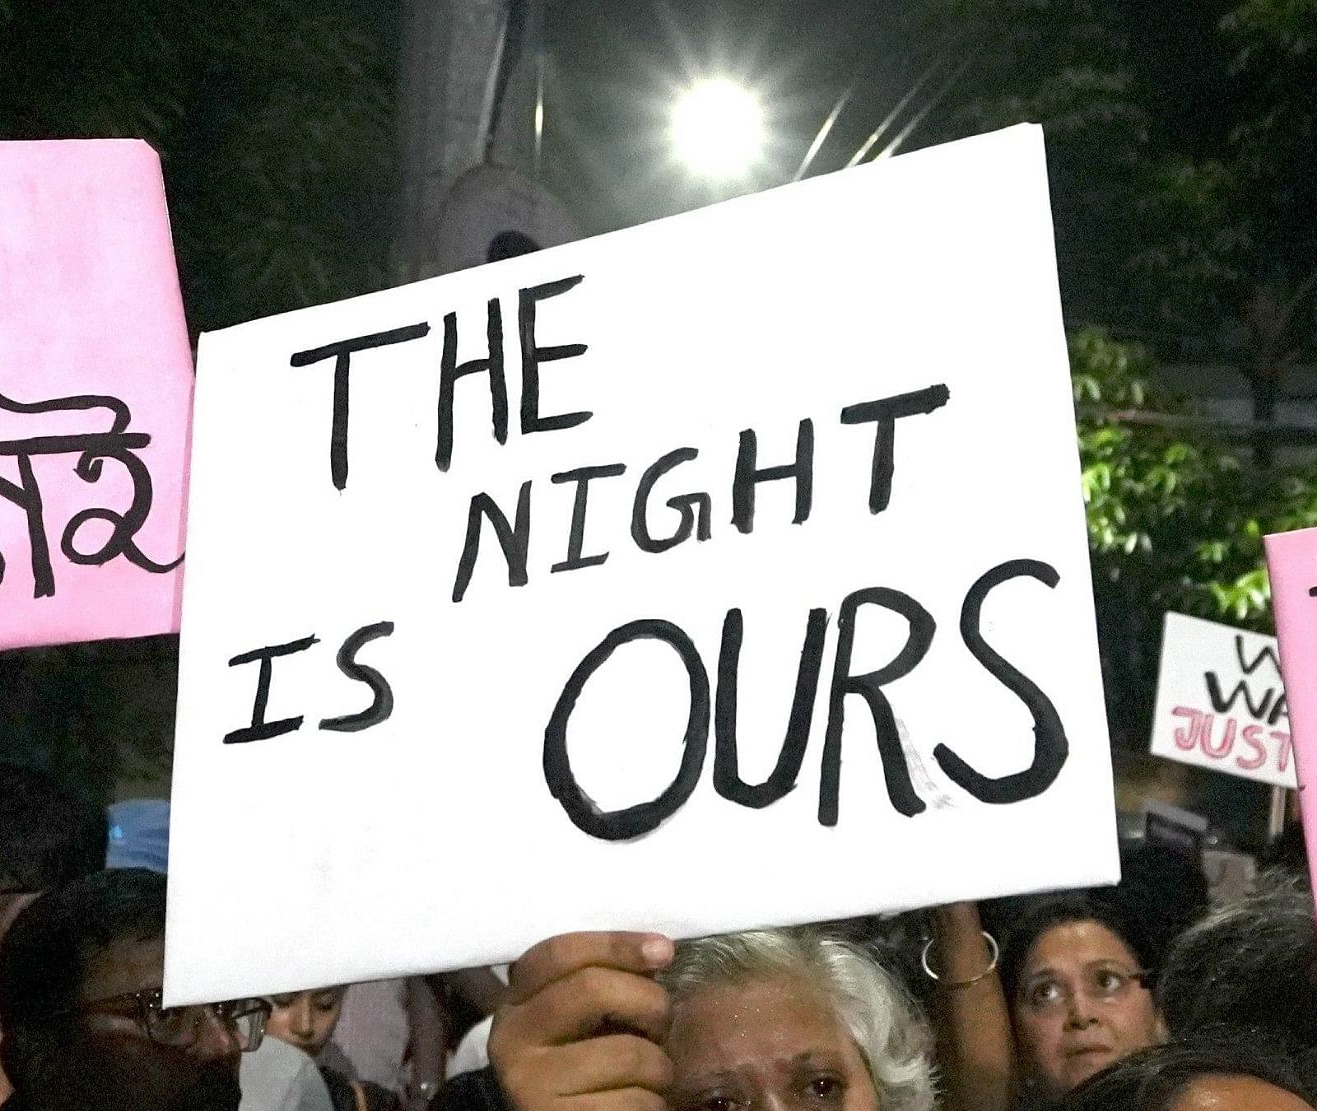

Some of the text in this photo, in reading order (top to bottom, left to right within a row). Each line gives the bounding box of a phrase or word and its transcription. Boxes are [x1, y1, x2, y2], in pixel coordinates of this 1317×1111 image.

[289, 273, 595, 492] THE
[451, 383, 951, 603] NIGHT
[223, 620, 397, 746] IS
[542, 558, 1070, 843] OURS
